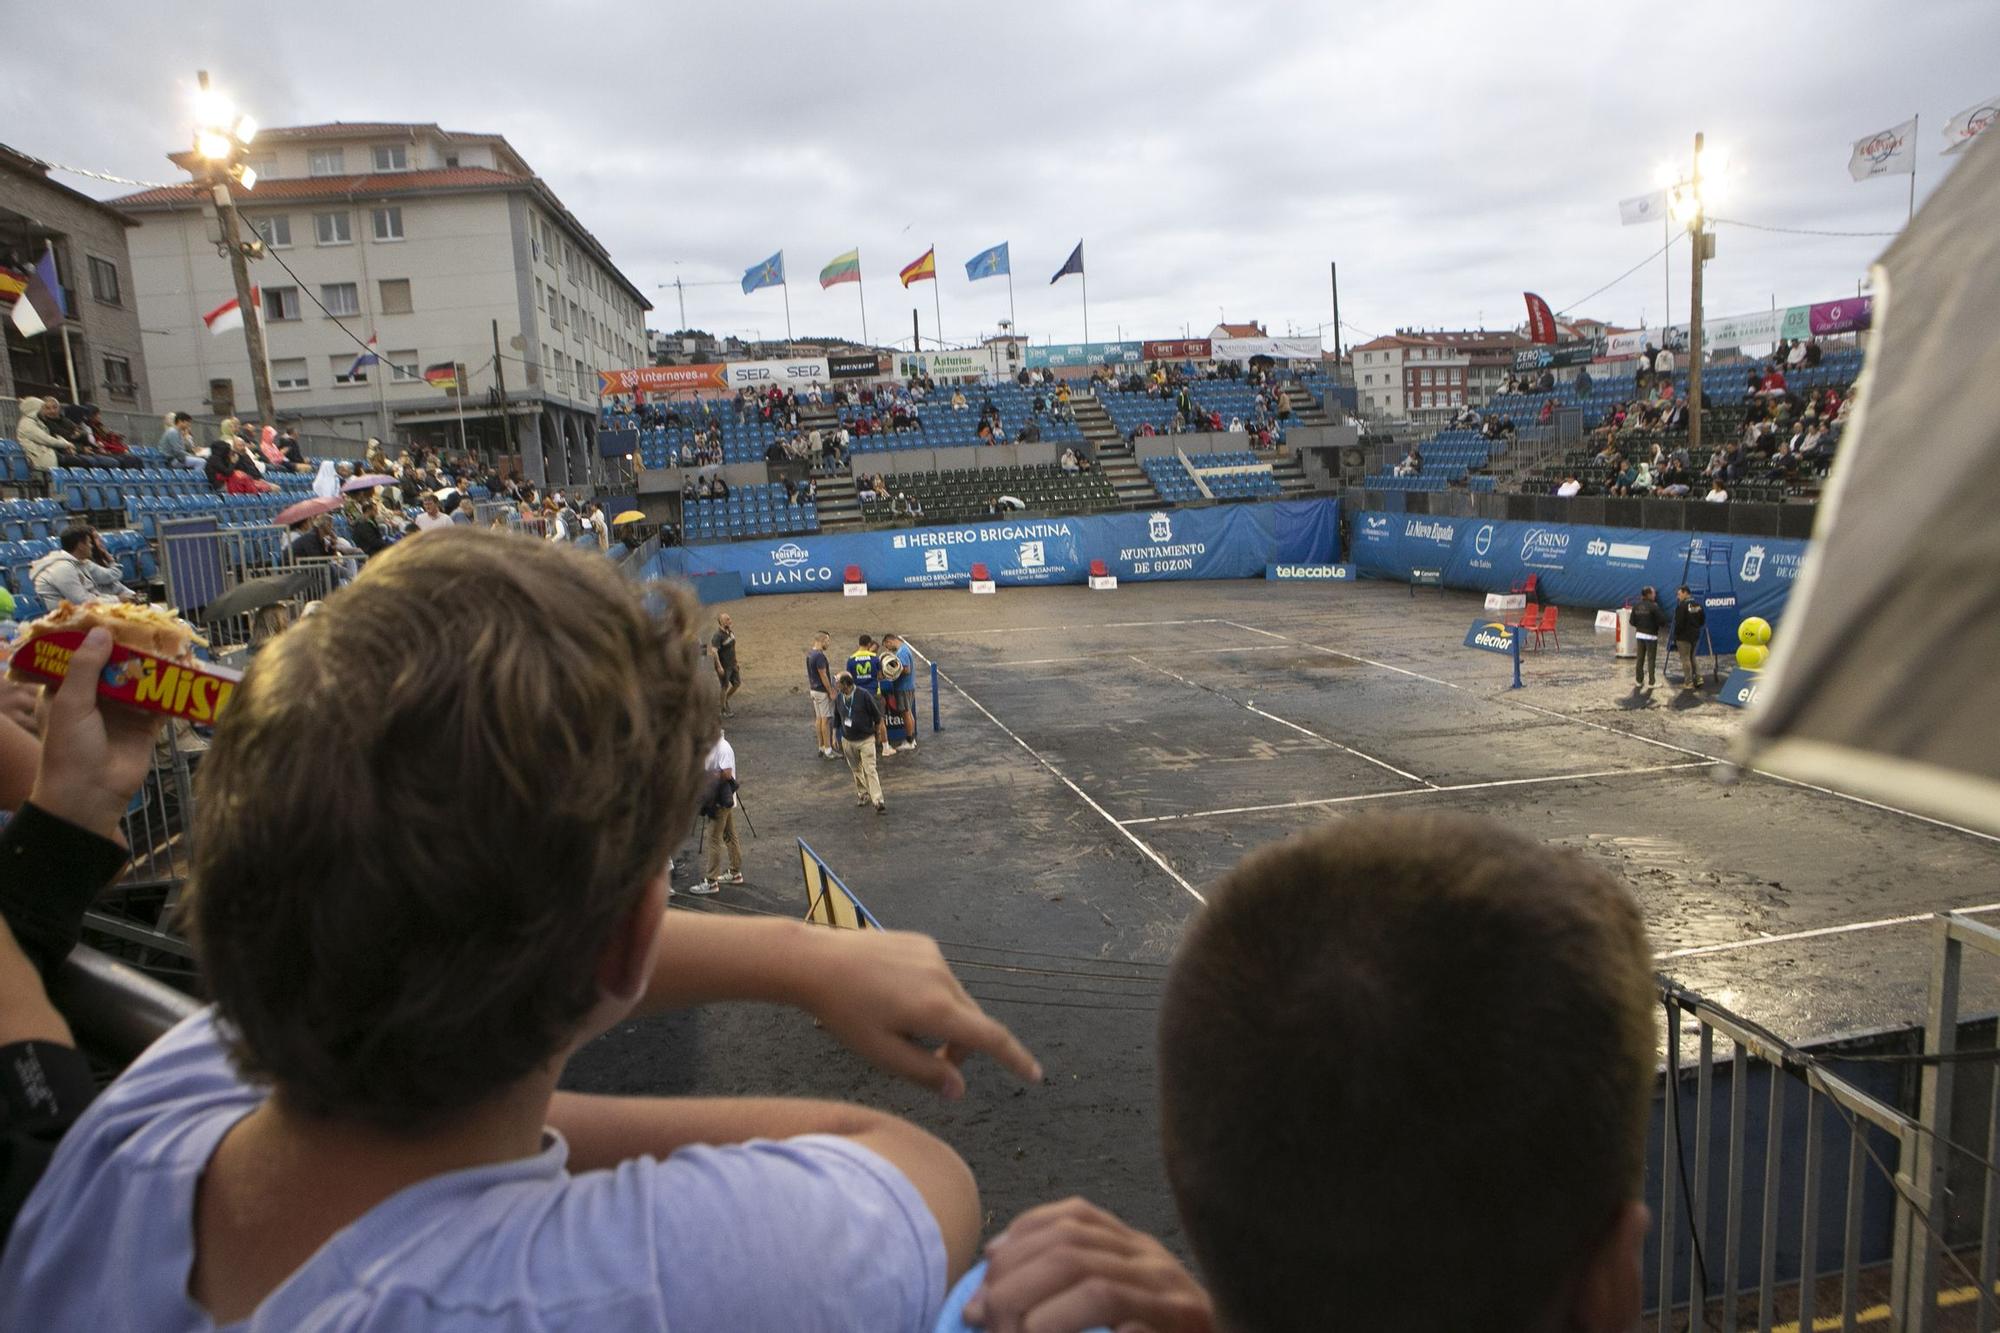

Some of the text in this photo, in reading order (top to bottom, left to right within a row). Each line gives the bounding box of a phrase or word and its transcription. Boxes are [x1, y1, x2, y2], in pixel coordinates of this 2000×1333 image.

[933, 356, 972, 366] Asturias
[1517, 350, 1538, 363] ZERO
[786, 365, 821, 378] SER
[840, 362, 875, 371] DUNLOP
[736, 368, 770, 382] SER
[910, 523, 1071, 547] HERRERO BRIGANTINA
[1405, 520, 1413, 536] La
[1413, 521, 1431, 538] Nueva
[1430, 522, 1454, 543] España
[1521, 528, 1570, 560] CASINO
[1586, 537, 1607, 556] sto
[1120, 543, 1205, 561] AYUNTAMIENTO
[1001, 565, 1066, 577] HERRERO BRIGANTINA
[1134, 562, 1150, 574] DE
[1276, 565, 1346, 578] telecable
[1776, 567, 1787, 578] DE
[751, 567, 832, 586] LUANCO
[904, 572, 971, 584] HERRERO BRIGANTINA
[1474, 631, 1513, 650] elecnor
